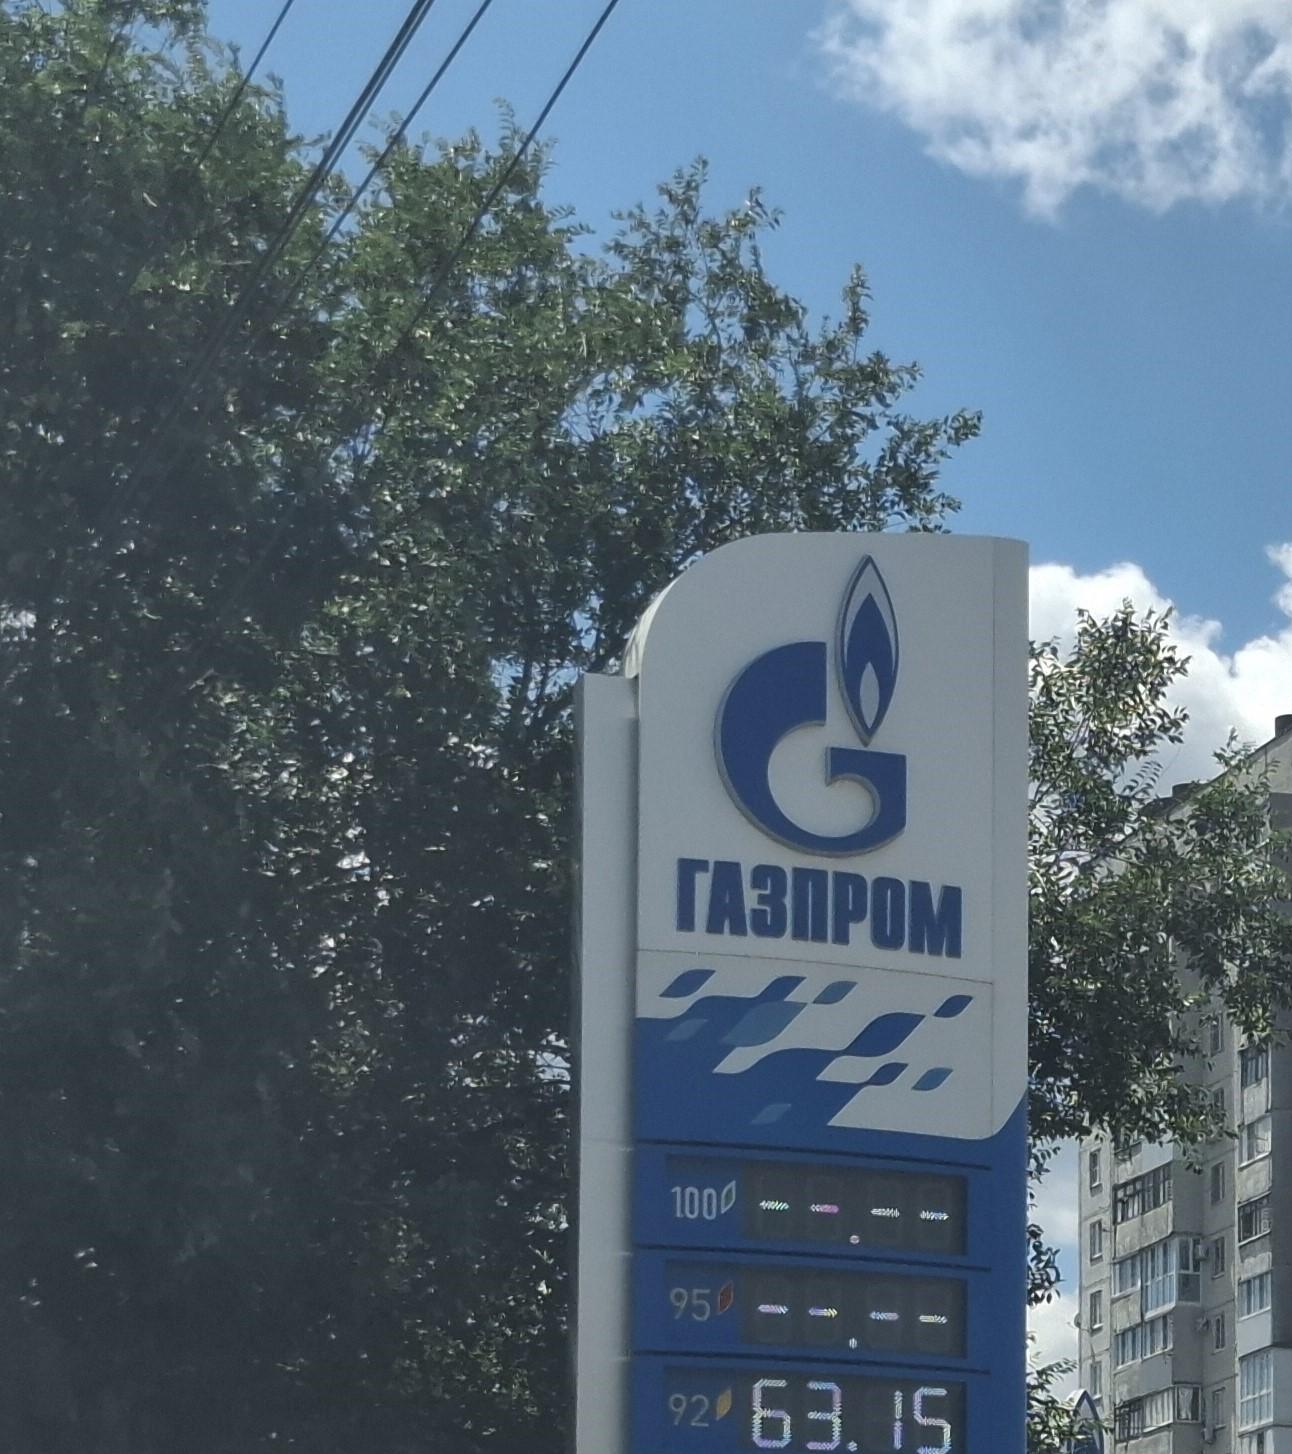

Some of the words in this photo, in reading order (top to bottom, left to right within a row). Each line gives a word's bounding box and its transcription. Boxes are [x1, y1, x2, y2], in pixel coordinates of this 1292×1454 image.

[675, 856, 963, 959] ГАЗПРОМ
[670, 1185, 717, 1220] 100
[669, 1287, 711, 1322] 95
[669, 1393, 710, 1427] 92
